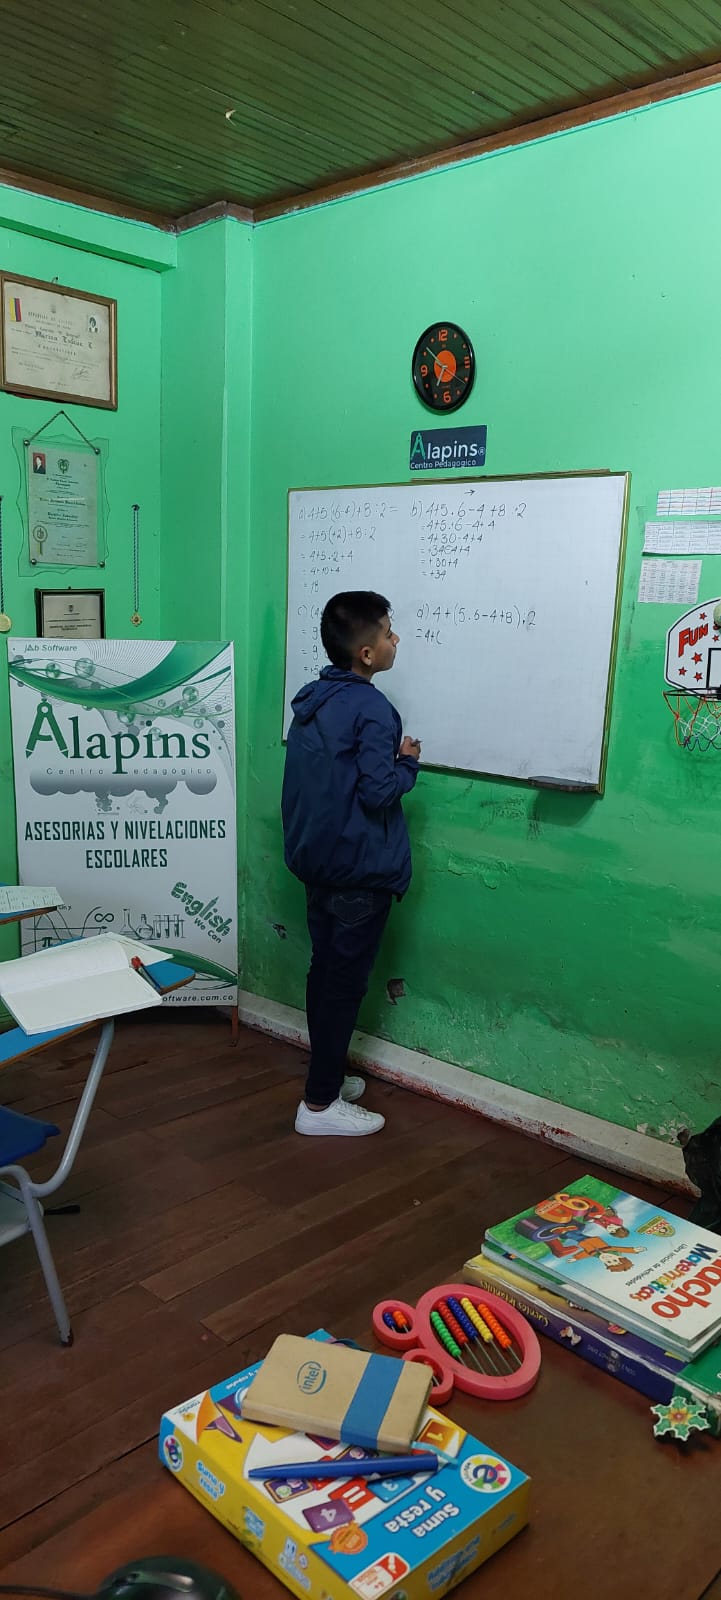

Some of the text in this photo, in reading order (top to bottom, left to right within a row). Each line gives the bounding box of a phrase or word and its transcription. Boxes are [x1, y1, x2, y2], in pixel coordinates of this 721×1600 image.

[438, 330, 448, 342] 12
[420, 365, 428, 377] 9
[444, 391, 452, 404] 6
[678, 623, 708, 658] FUN
[25, 698, 212, 775] Alapins
[46, 767, 104, 775] Centro
[25, 820, 226, 841] ASESORIAS Y NIVELACIONES
[86, 849, 168, 868] ESCOLARES
[171, 882, 232, 936] English
[194, 918, 222, 944] We Can
[162, 995, 234, 1004] oftware.com.co
[629, 1243, 718, 1302] Matemáticas
[518, 1302, 550, 1326] Cuentos
[298, 1364, 321, 1390] intel
[384, 1485, 446, 1532] y resta
[412, 1503, 460, 1537] Suma
